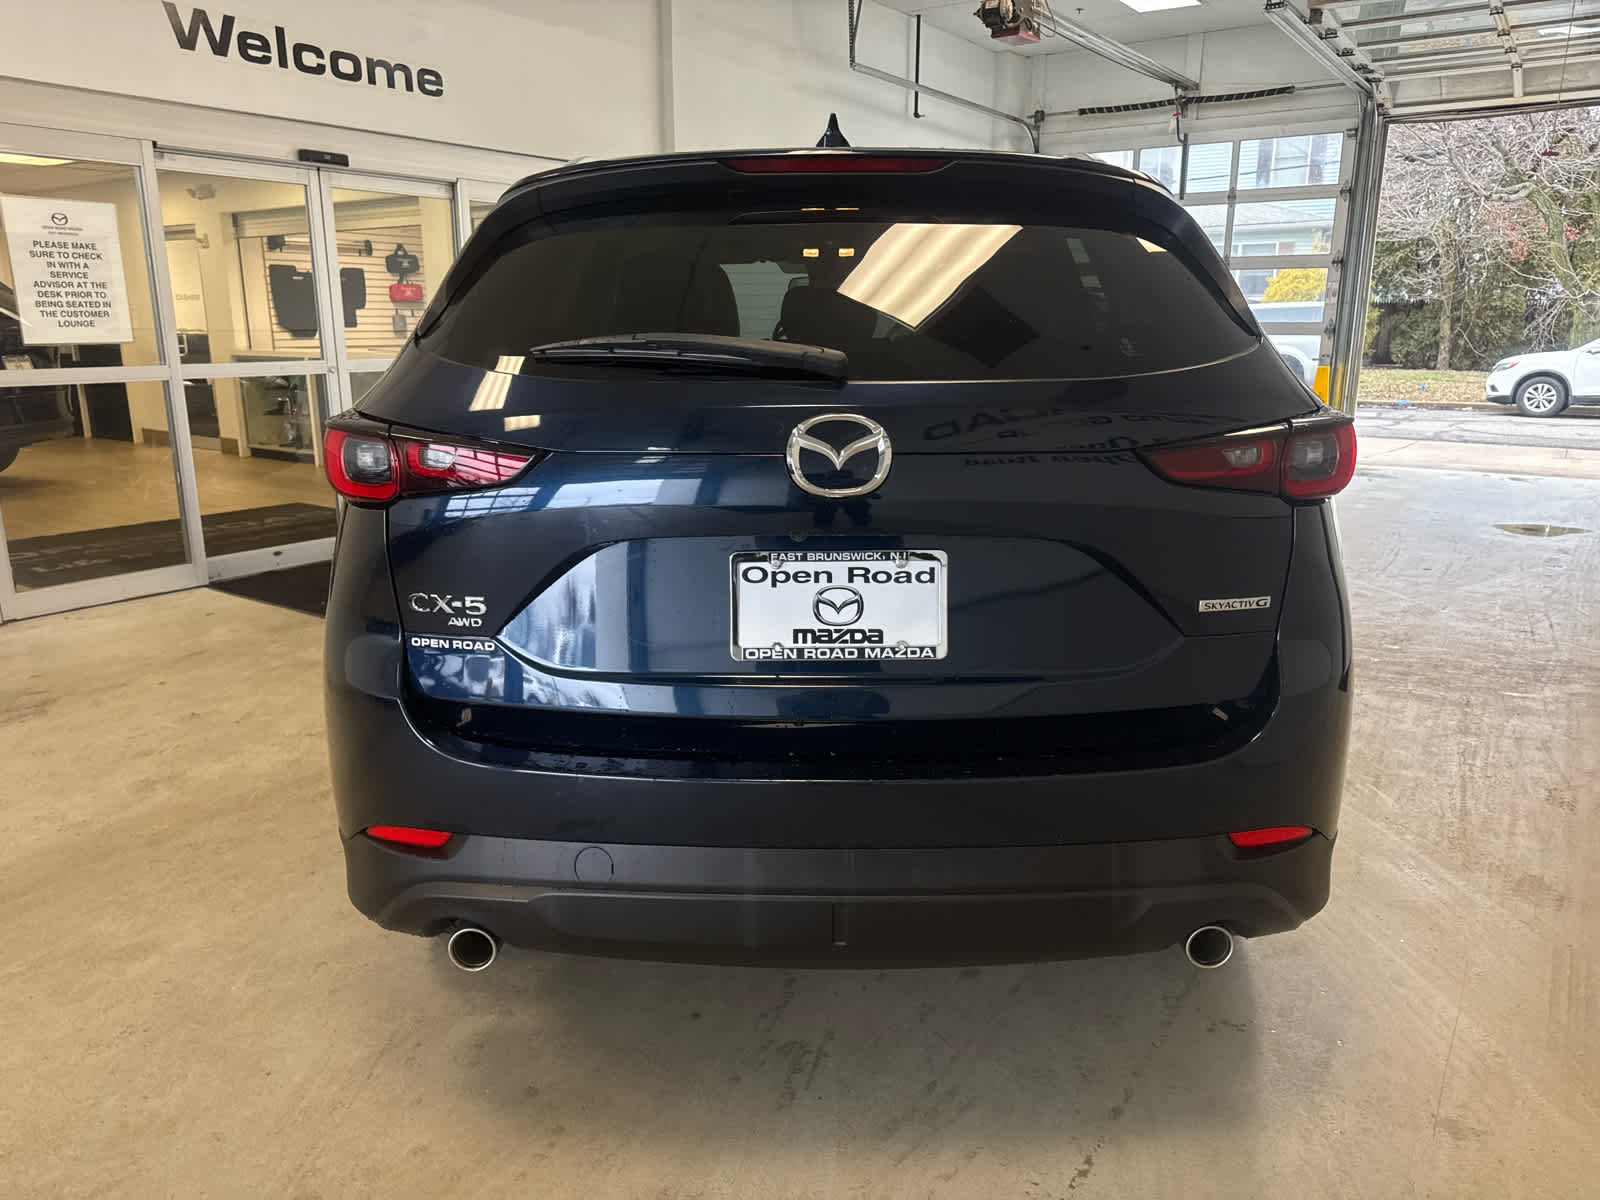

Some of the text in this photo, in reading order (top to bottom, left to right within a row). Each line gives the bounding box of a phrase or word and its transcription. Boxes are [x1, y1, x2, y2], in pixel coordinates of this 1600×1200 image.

[161, 0, 444, 98] Welcome
[33, 240, 97, 250] PLEASE MAKE
[29, 250, 103, 261] SURE TO CHECK
[46, 261, 56, 269] IN
[58, 262, 81, 270] WITH
[50, 271, 89, 279] SERVICE
[34, 281, 74, 289] ADVISOR
[77, 281, 89, 289] AT
[38, 290, 107, 299] DESK PRIOR TO
[35, 300, 112, 309] BEING SEATED IN
[40, 310, 110, 319] THE CUSTOMER
[58, 320, 96, 328] LOUNGE
[742, 566, 936, 588] Open Road
[408, 592, 487, 615] CX-5
[447, 617, 482, 627] AWD
[411, 637, 495, 651] OPEN ROAD
[745, 647, 935, 659] OPEN ROAD MAZDA
